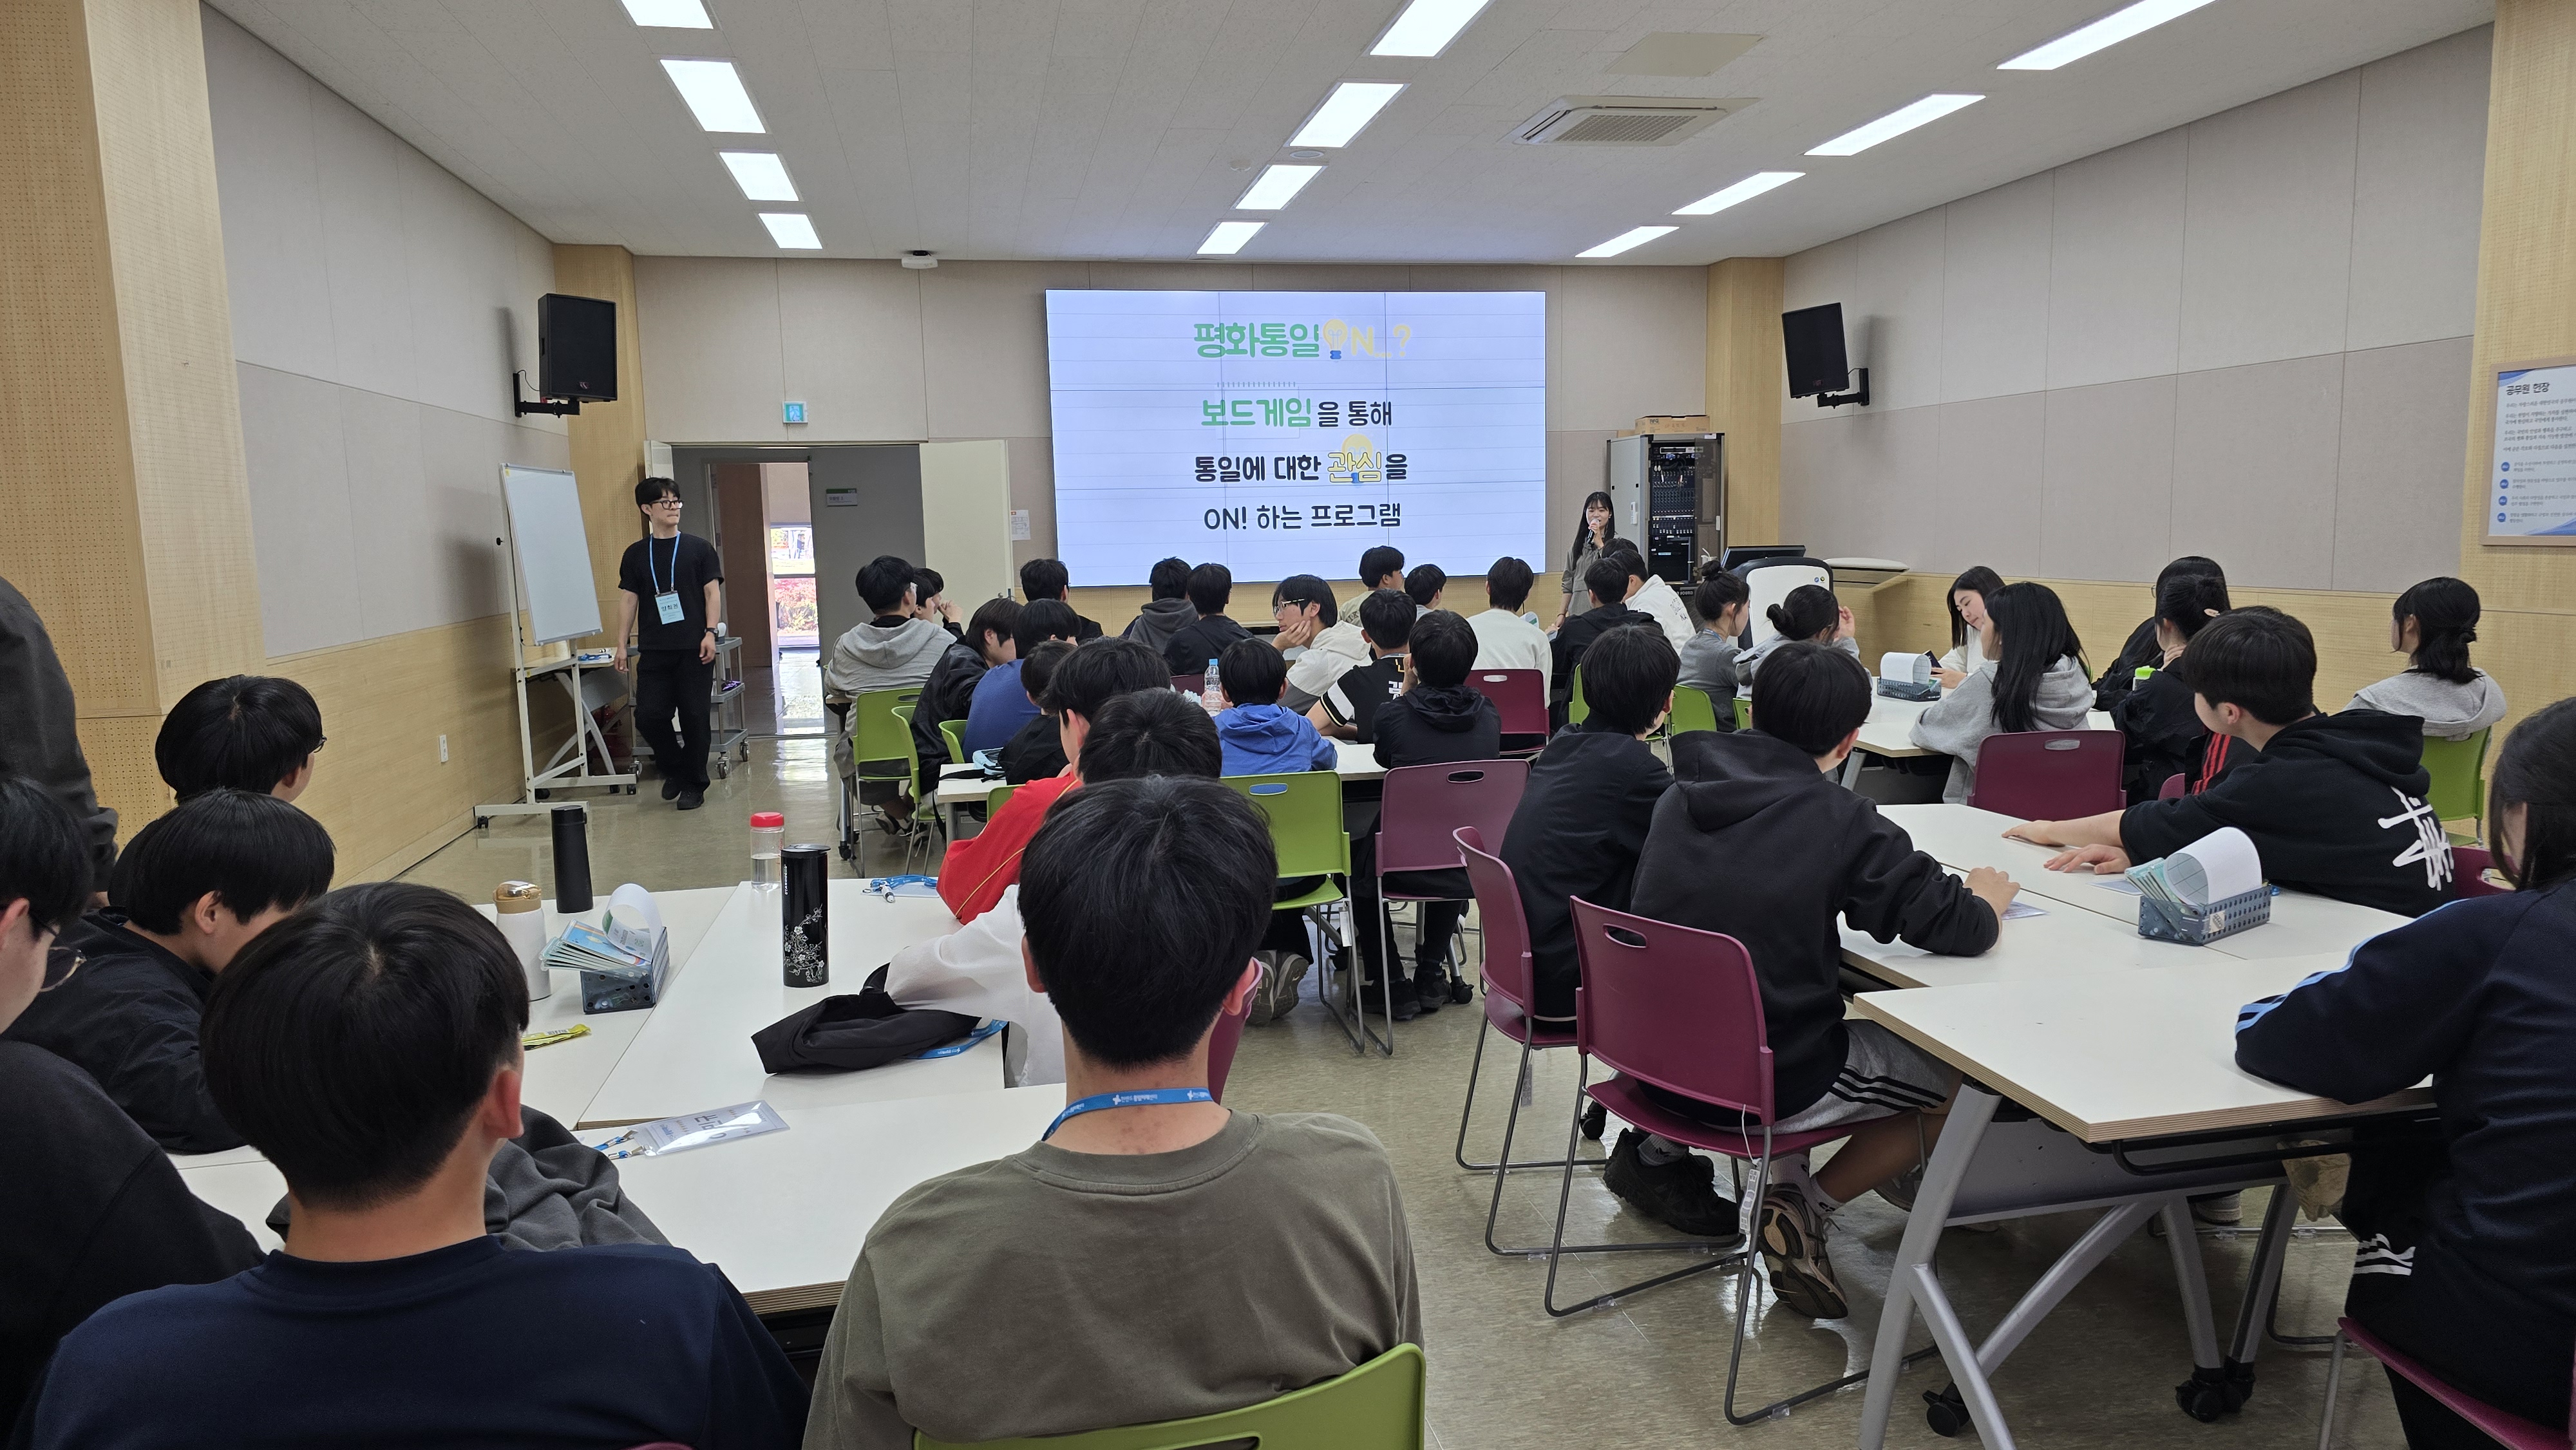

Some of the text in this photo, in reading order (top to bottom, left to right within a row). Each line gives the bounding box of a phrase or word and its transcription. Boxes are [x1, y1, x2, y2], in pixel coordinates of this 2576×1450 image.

[2506, 384, 2530, 395] 공무원
[1201, 398, 1311, 427] 보드게임
[1348, 401, 1392, 426] 통해
[1195, 456, 1265, 482] 통일에
[1274, 455, 1321, 481] 대한
[1204, 503, 1401, 530] ON! 하는 프로그램
